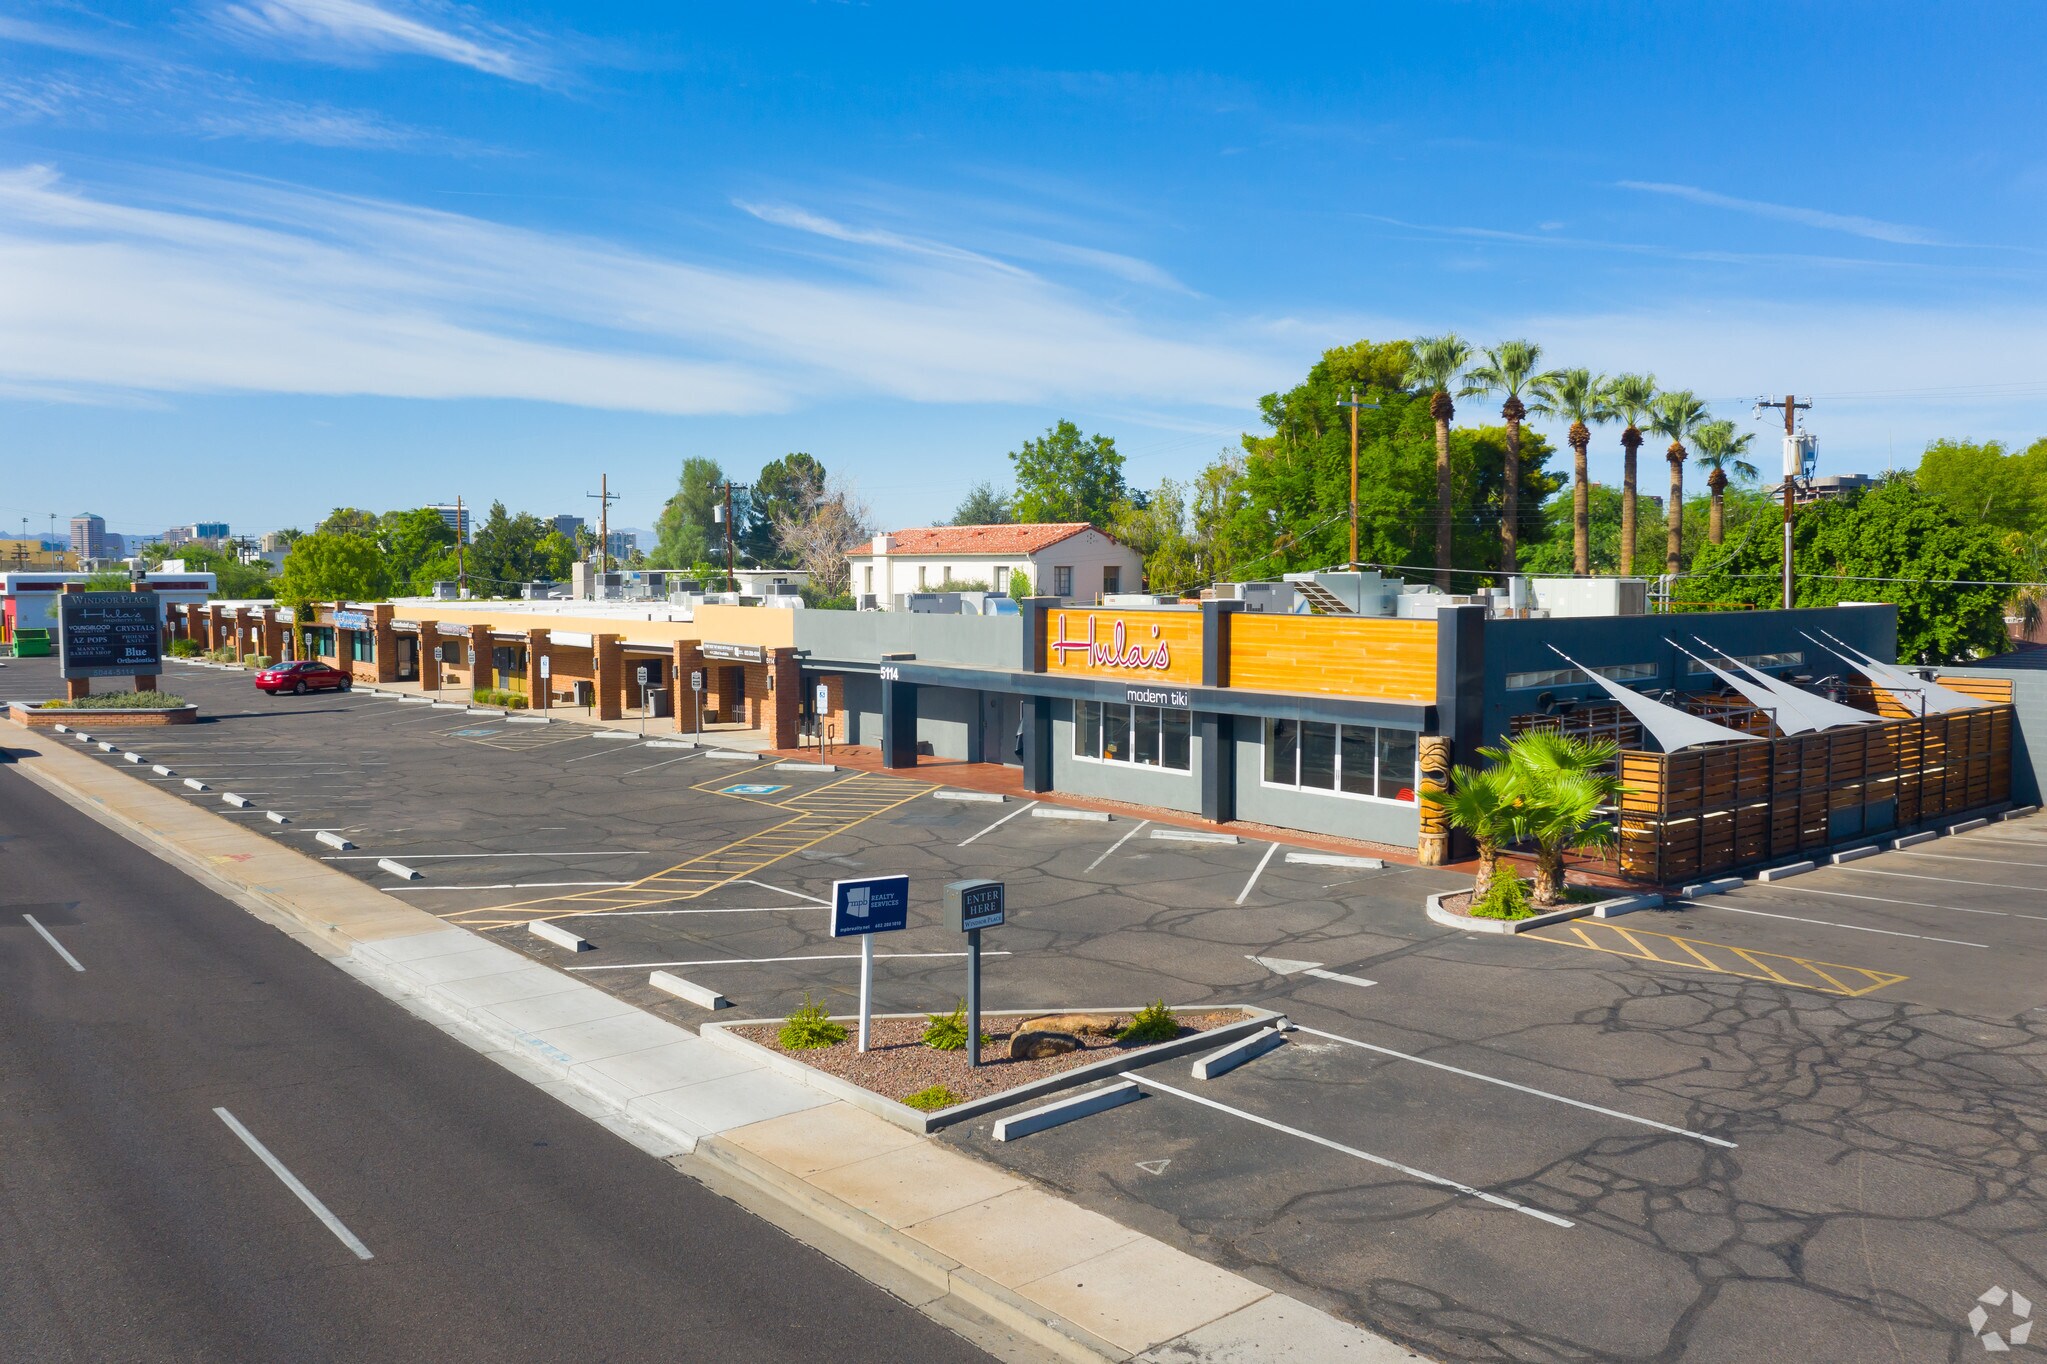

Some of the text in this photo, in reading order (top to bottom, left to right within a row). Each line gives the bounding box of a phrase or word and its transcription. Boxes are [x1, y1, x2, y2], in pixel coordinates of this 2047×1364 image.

[79, 608, 142, 619] Hula's
[1051, 613, 1171, 670] Hula's
[125, 647, 147, 657] Blue
[880, 666, 899, 681] 5114
[1127, 689, 1188, 706] modern tiki
[851, 899, 868, 907] mpb
[871, 893, 894, 901] REALTY
[967, 890, 999, 905] ENTER
[870, 899, 899, 908] SERVICES
[970, 901, 997, 915] HERE
